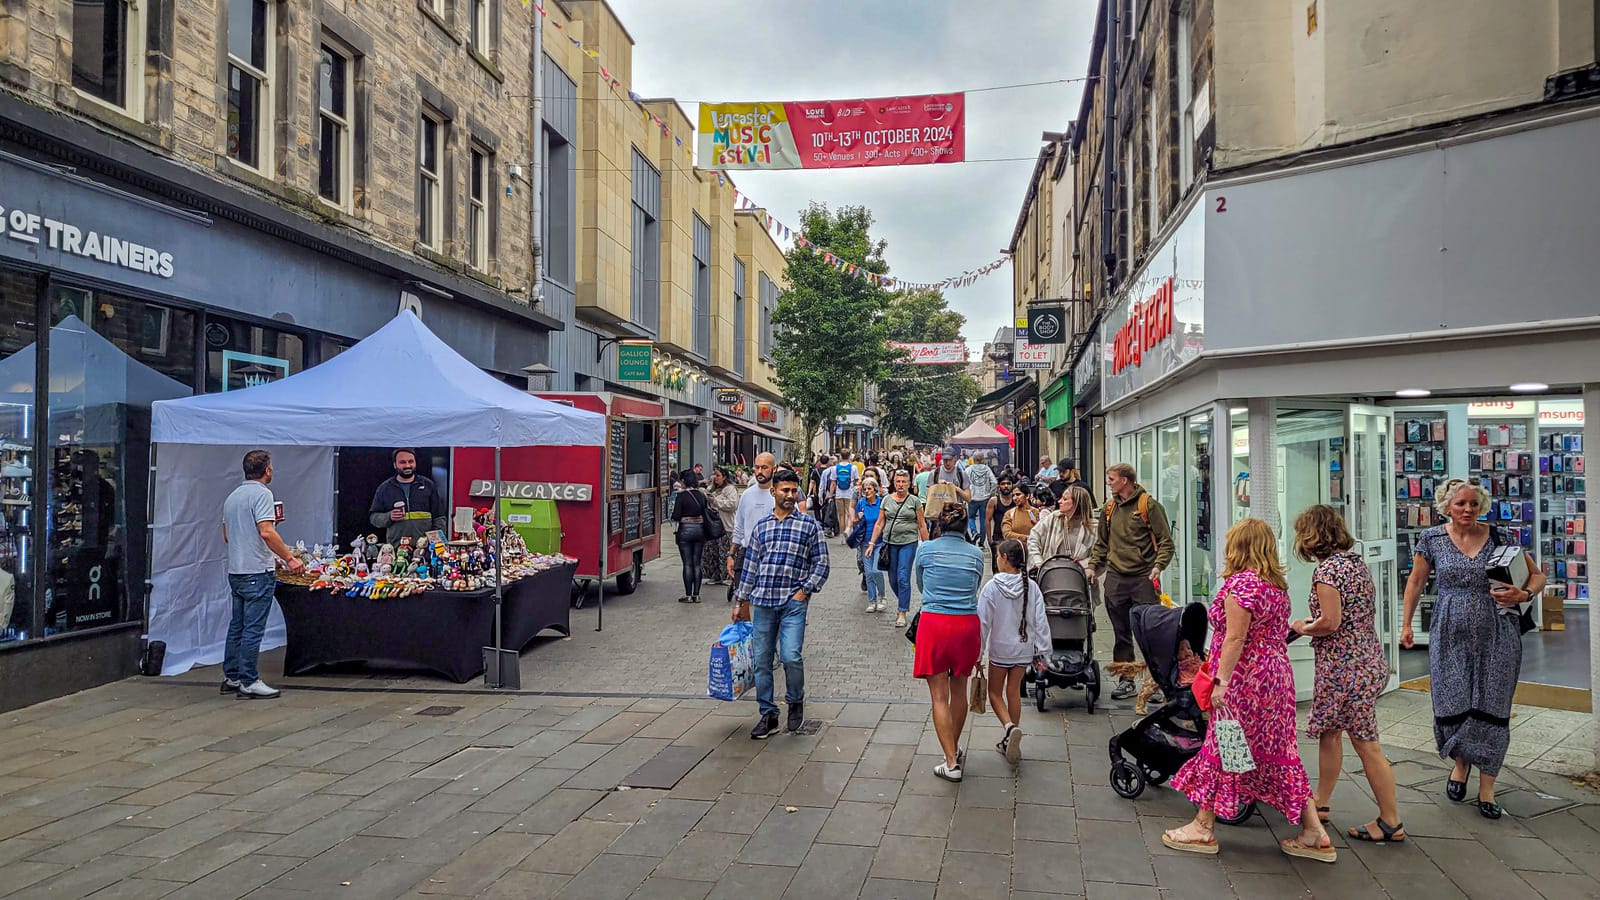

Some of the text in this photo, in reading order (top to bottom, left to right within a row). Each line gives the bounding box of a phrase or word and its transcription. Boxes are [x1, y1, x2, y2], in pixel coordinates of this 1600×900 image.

[713, 124, 772, 149] MUSIC
[864, 128, 920, 145] OCTOBER
[923, 125, 953, 142] 2024
[813, 152, 854, 161] 50+ Venues
[884, 150, 900, 158] Acts
[911, 146, 953, 156] 400+ Shows
[1216, 196, 1227, 213] 2
[10, 210, 40, 234] OF
[44, 218, 174, 277] TRAINERS
[620, 350, 650, 358] GALLICO
[1539, 409, 1584, 420] msung
